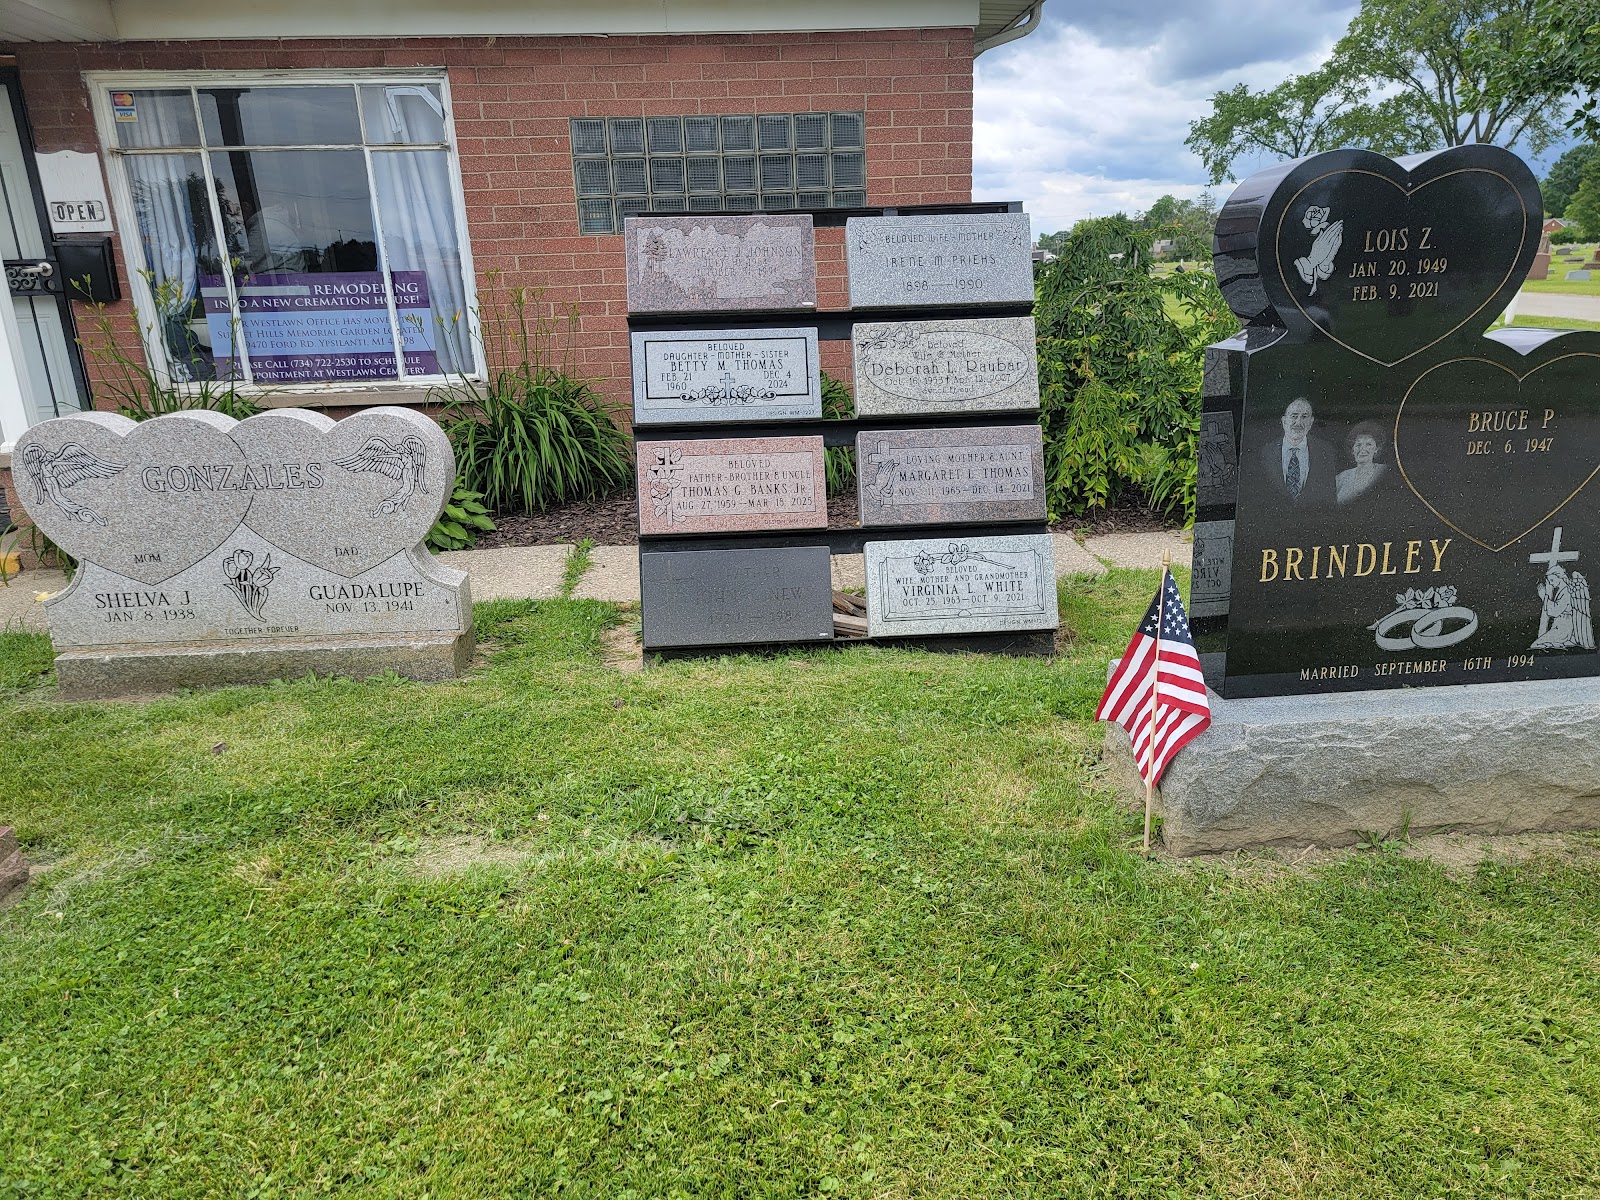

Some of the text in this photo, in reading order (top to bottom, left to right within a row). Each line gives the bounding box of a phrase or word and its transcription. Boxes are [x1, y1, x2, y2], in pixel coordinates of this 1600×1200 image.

[56, 204, 97, 221] OPEN
[885, 234, 924, 244] BELOVED
[958, 232, 994, 241] MOTHER
[1363, 227, 1437, 253] LOIS Z.
[746, 245, 801, 258] JOHNSON
[885, 256, 924, 268] IRENE
[1348, 261, 1381, 279] JAN.
[1416, 257, 1448, 275] 1949
[313, 282, 419, 296] REMODELNG
[1352, 284, 1382, 302] FEB.
[1408, 281, 1439, 299] 2021
[214, 298, 248, 309] INO
[250, 299, 260, 309] A
[262, 298, 292, 308] NEW
[294, 296, 370, 308] CREMATION
[225, 319, 249, 328] OR
[250, 317, 304, 328] WESTLAWN
[306, 316, 341, 326] OFFICE
[343, 316, 361, 326] HAS
[364, 316, 391, 325] MOVE
[217, 327, 425, 339] SUET HILLS MEMORIAL GARDEN LOATED
[270, 340, 297, 349] FORD
[372, 337, 385, 346] MI
[387, 336, 415, 345] 498
[707, 342, 745, 352] BELOVED
[663, 351, 709, 361] DAUGHTER
[717, 351, 752, 360] MOTHER
[761, 350, 789, 359] SISTER
[232, 356, 421, 370] PLASE CALL (734) 722-2530 TO SCHEULE
[670, 360, 708, 372] BETTY
[735, 359, 784, 371] THOMAS
[871, 357, 1022, 377] Deborah L. Raubar
[251, 370, 312, 380] PPOINTMENT
[313, 370, 324, 378] AT
[326, 367, 377, 377] WESTLAWN
[379, 366, 426, 376] CEMTERY
[661, 372, 693, 382] FEB. 21
[786, 370, 792, 379] 4
[666, 381, 687, 391] 1960
[768, 379, 788, 389] 2024
[1467, 408, 1558, 433] BRUCE P.
[1466, 440, 1495, 455] DEC.
[1525, 437, 1554, 453] 1947
[728, 459, 771, 469] BELOVED
[906, 454, 941, 465] LOVING
[948, 452, 985, 463] MOTHER
[999, 451, 1023, 461] AUNT
[141, 462, 325, 493] GONZALES
[782, 470, 811, 480] UNCLE
[899, 468, 961, 481] MARGARET
[983, 466, 1029, 479] THOMAS
[681, 485, 728, 498] THOMAS
[750, 483, 788, 495] BANKS
[1011, 483, 1031, 493] 2021
[791, 496, 813, 506] 2025
[334, 546, 359, 557] DAD
[134, 553, 162, 564] MOM
[1259, 537, 1453, 583] BRINDLEY
[945, 565, 978, 574] BELOVED
[920, 575, 950, 584] MOTHER
[954, 574, 970, 582] AND
[974, 571, 1029, 581] GRANDMOTHER
[309, 582, 425, 600] GUADALUPE
[902, 580, 1024, 597] VIRGINIA L. WHITE
[95, 591, 171, 609] SHELVA
[1006, 592, 1025, 602] 2021
[386, 600, 414, 612] 1941
[163, 608, 196, 621] 1938
[224, 625, 300, 635] TOGETHER FOREVER
[1299, 654, 1535, 681] MARRIED SEPTEMBER 16TH 1994
